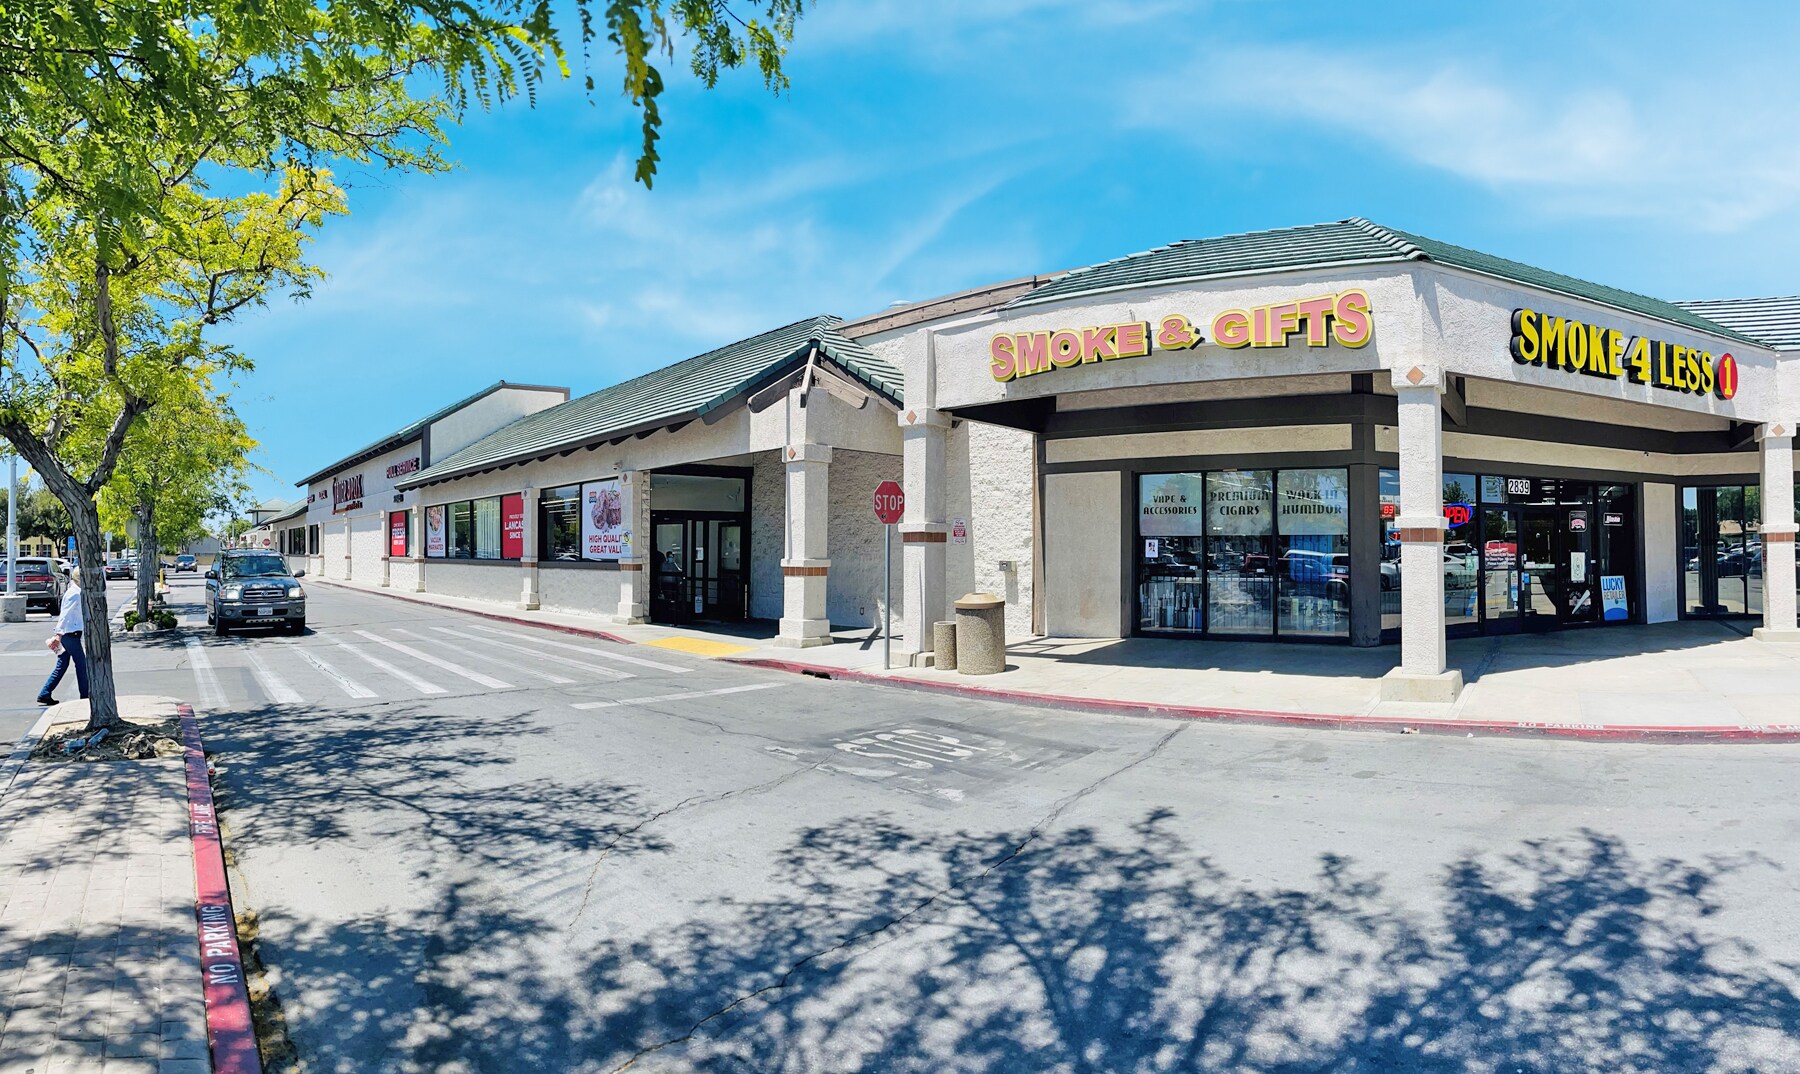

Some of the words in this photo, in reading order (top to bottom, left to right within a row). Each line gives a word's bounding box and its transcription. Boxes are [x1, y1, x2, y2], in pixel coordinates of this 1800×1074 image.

[989, 320, 1151, 382] SMOKE
[1155, 313, 1200, 350] &
[1211, 288, 1372, 349] GIFTS
[1514, 308, 1623, 377] SMOKE
[1626, 335, 1652, 382] 4
[1657, 340, 1715, 394] LESS
[1509, 480, 1529, 494] 2839
[1153, 494, 1176, 504] VAPE
[1179, 494, 1187, 503] &
[1210, 490, 1269, 502] PREMIUM
[874, 494, 904, 511] STOP
[1143, 505, 1197, 515] ACCESSORIES
[1219, 505, 1260, 515] CIGARS
[1282, 503, 1342, 515] HUMIDOR
[504, 520, 524, 530] LANCAS
[589, 535, 602, 543] HIGH
[603, 534, 622, 543] QUALI
[589, 545, 607, 554] GREAT
[608, 545, 622, 554] VAL
[1602, 577, 1624, 591] LUCKY
[1603, 590, 1626, 600] RETAILER
[1544, 722, 1604, 730] PARKING
[202, 904, 233, 957] PARKING
[209, 963, 239, 985] NO
